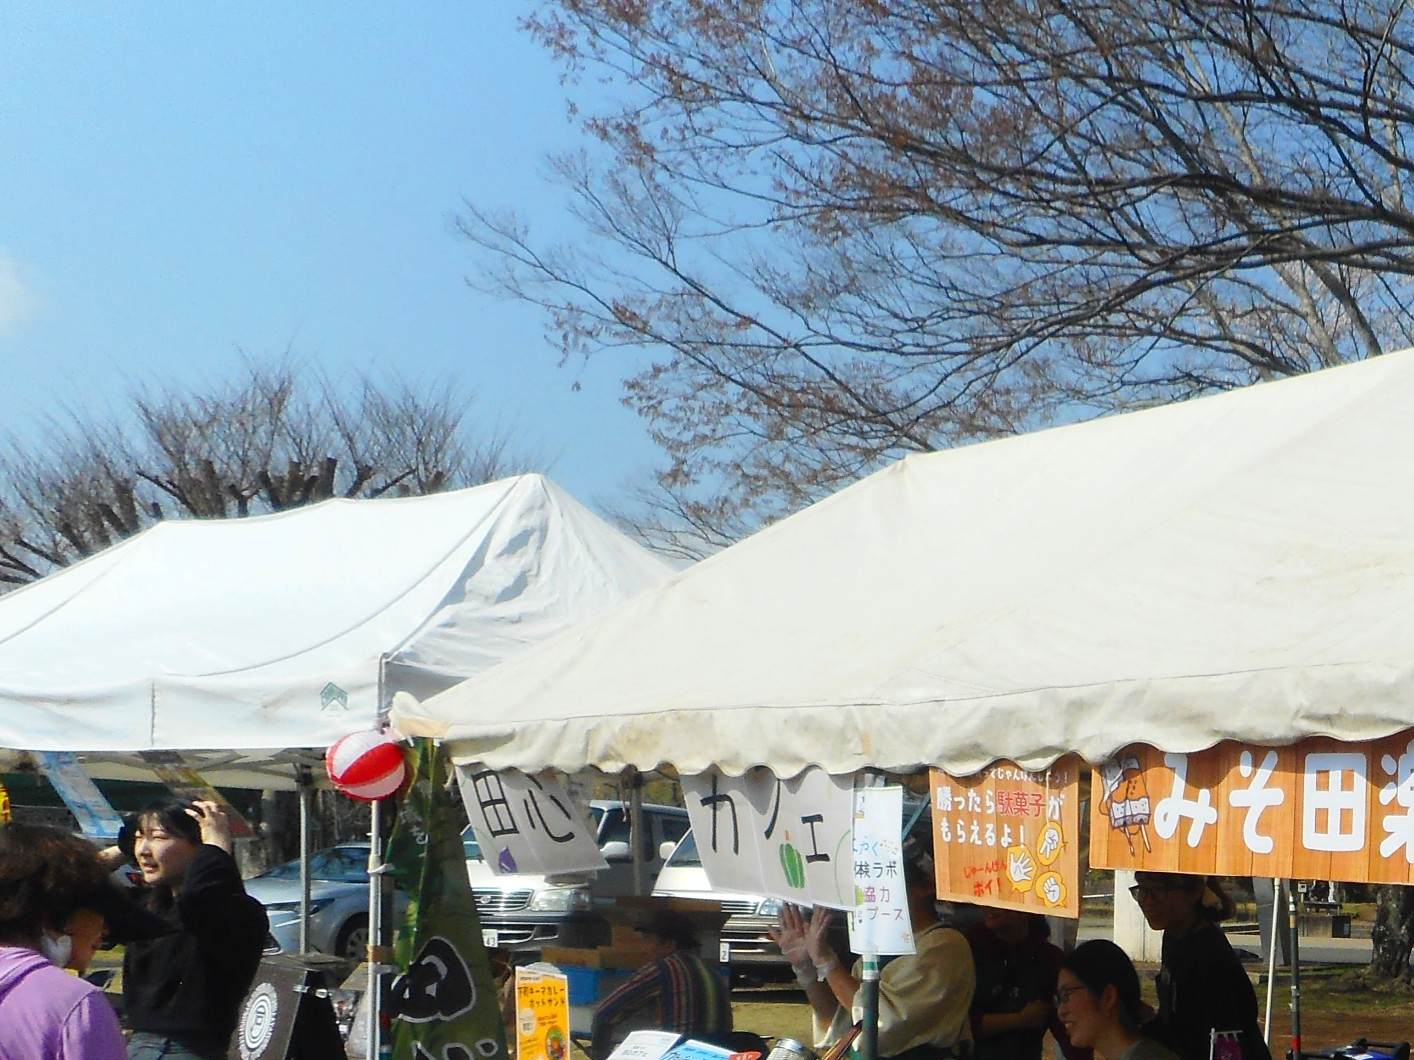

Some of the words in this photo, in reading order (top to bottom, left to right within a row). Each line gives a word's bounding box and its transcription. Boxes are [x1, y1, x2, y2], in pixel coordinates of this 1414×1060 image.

[936, 786, 1065, 820] 勝ったら駄菓子が
[940, 817, 1026, 848] もらえるよ！
[864, 886, 890, 903] 協力
[867, 906, 904, 921] ブース
